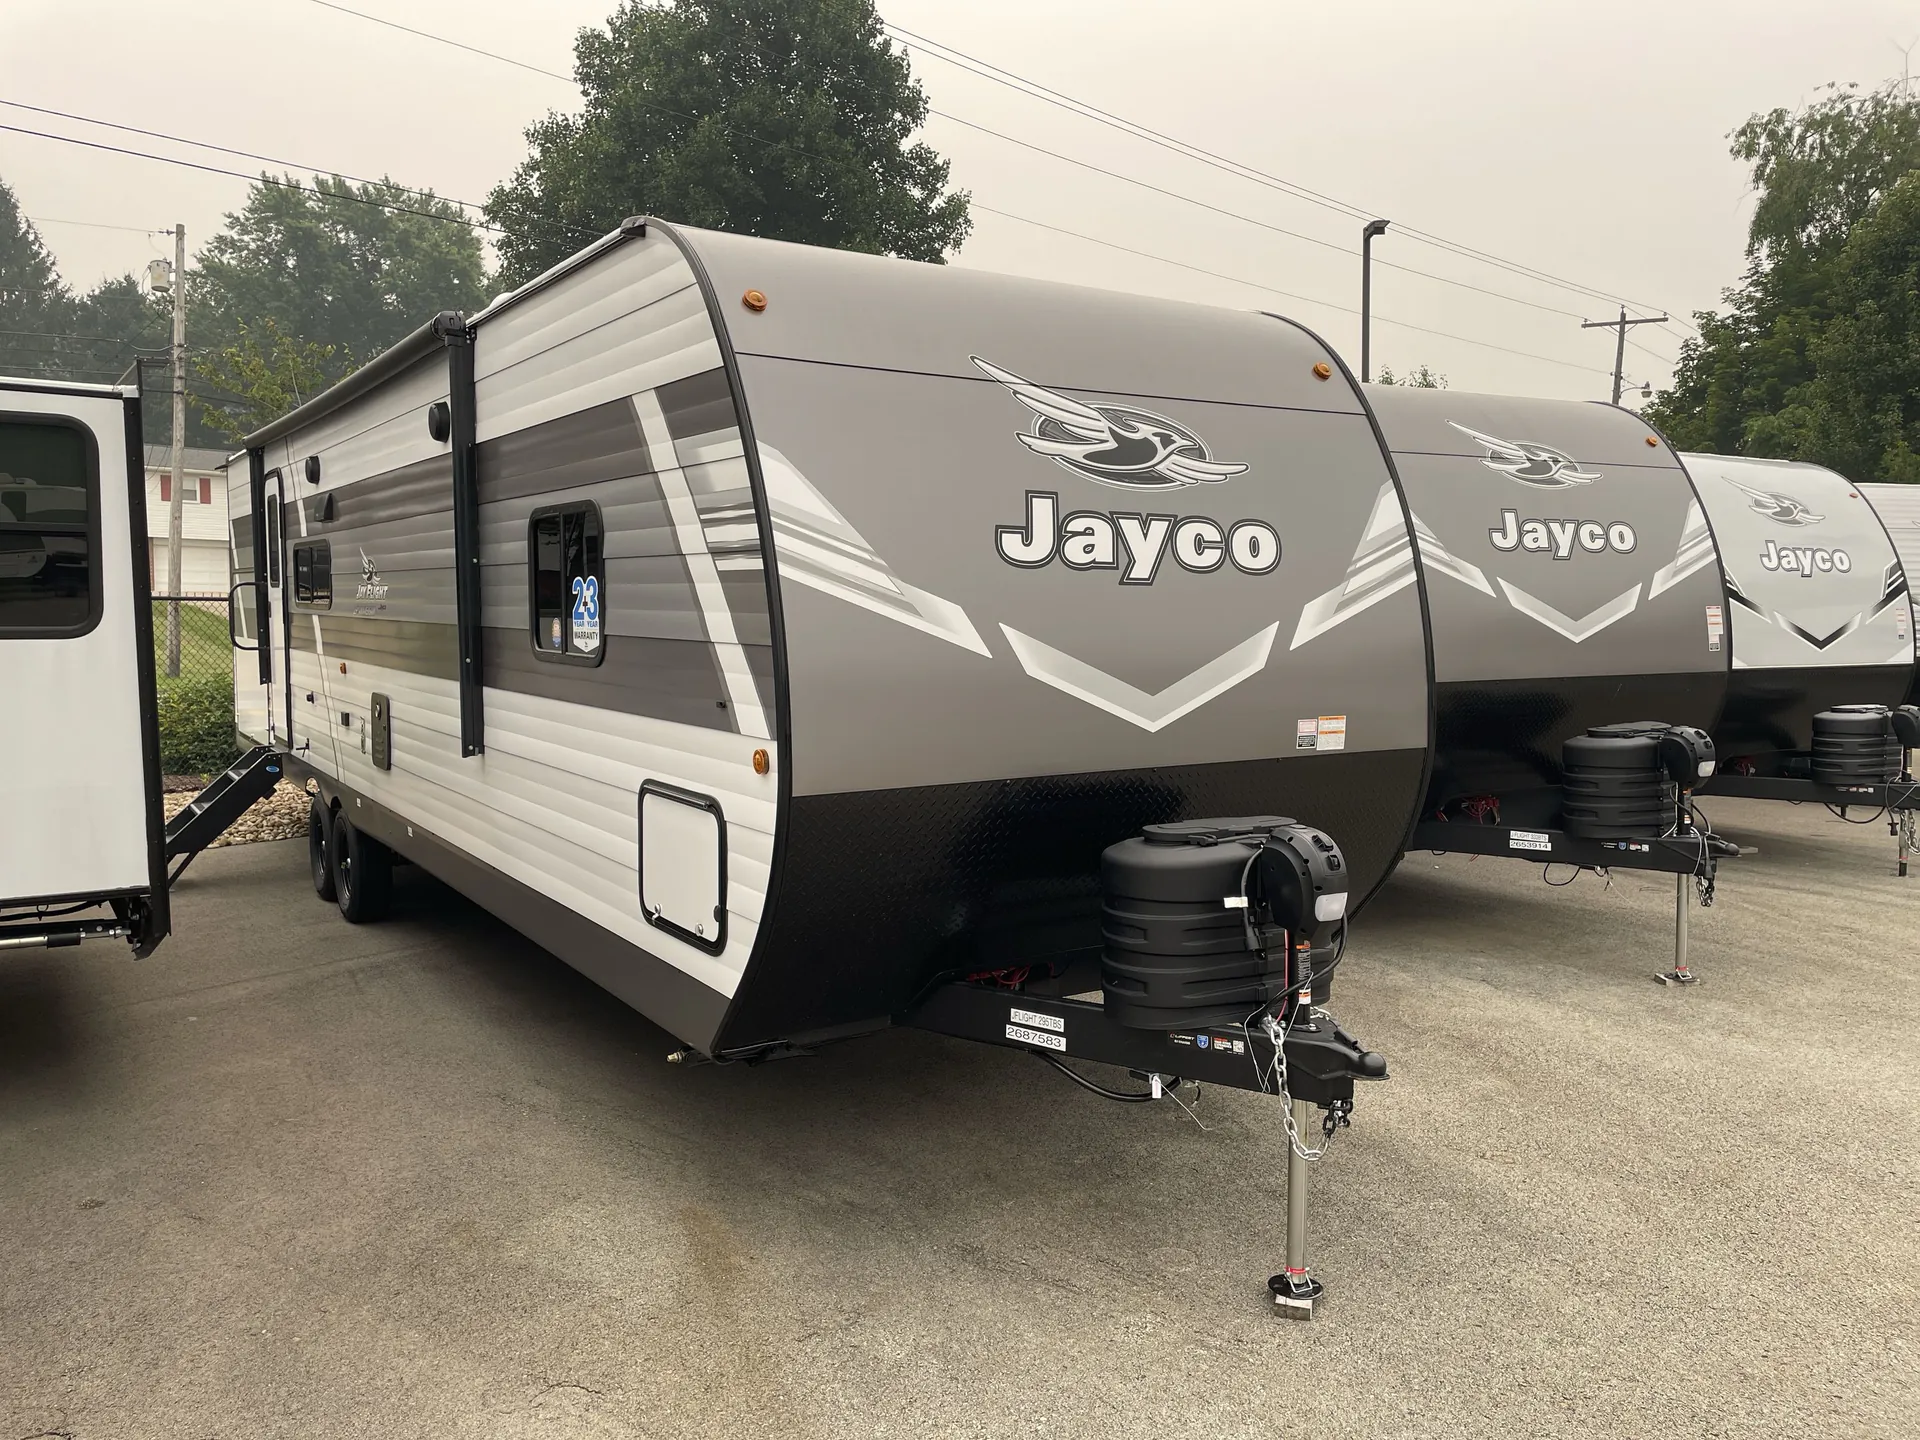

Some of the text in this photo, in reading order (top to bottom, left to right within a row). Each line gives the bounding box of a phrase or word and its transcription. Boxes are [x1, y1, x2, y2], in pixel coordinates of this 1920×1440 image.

[995, 489, 1282, 586] Jayco
[1489, 508, 1637, 560] Jayco
[1759, 540, 1852, 577] Jayco
[574, 631, 598, 640] WARRANTY
[1510, 841, 1548, 849] 2653914
[1007, 1027, 1061, 1048] 2687583
